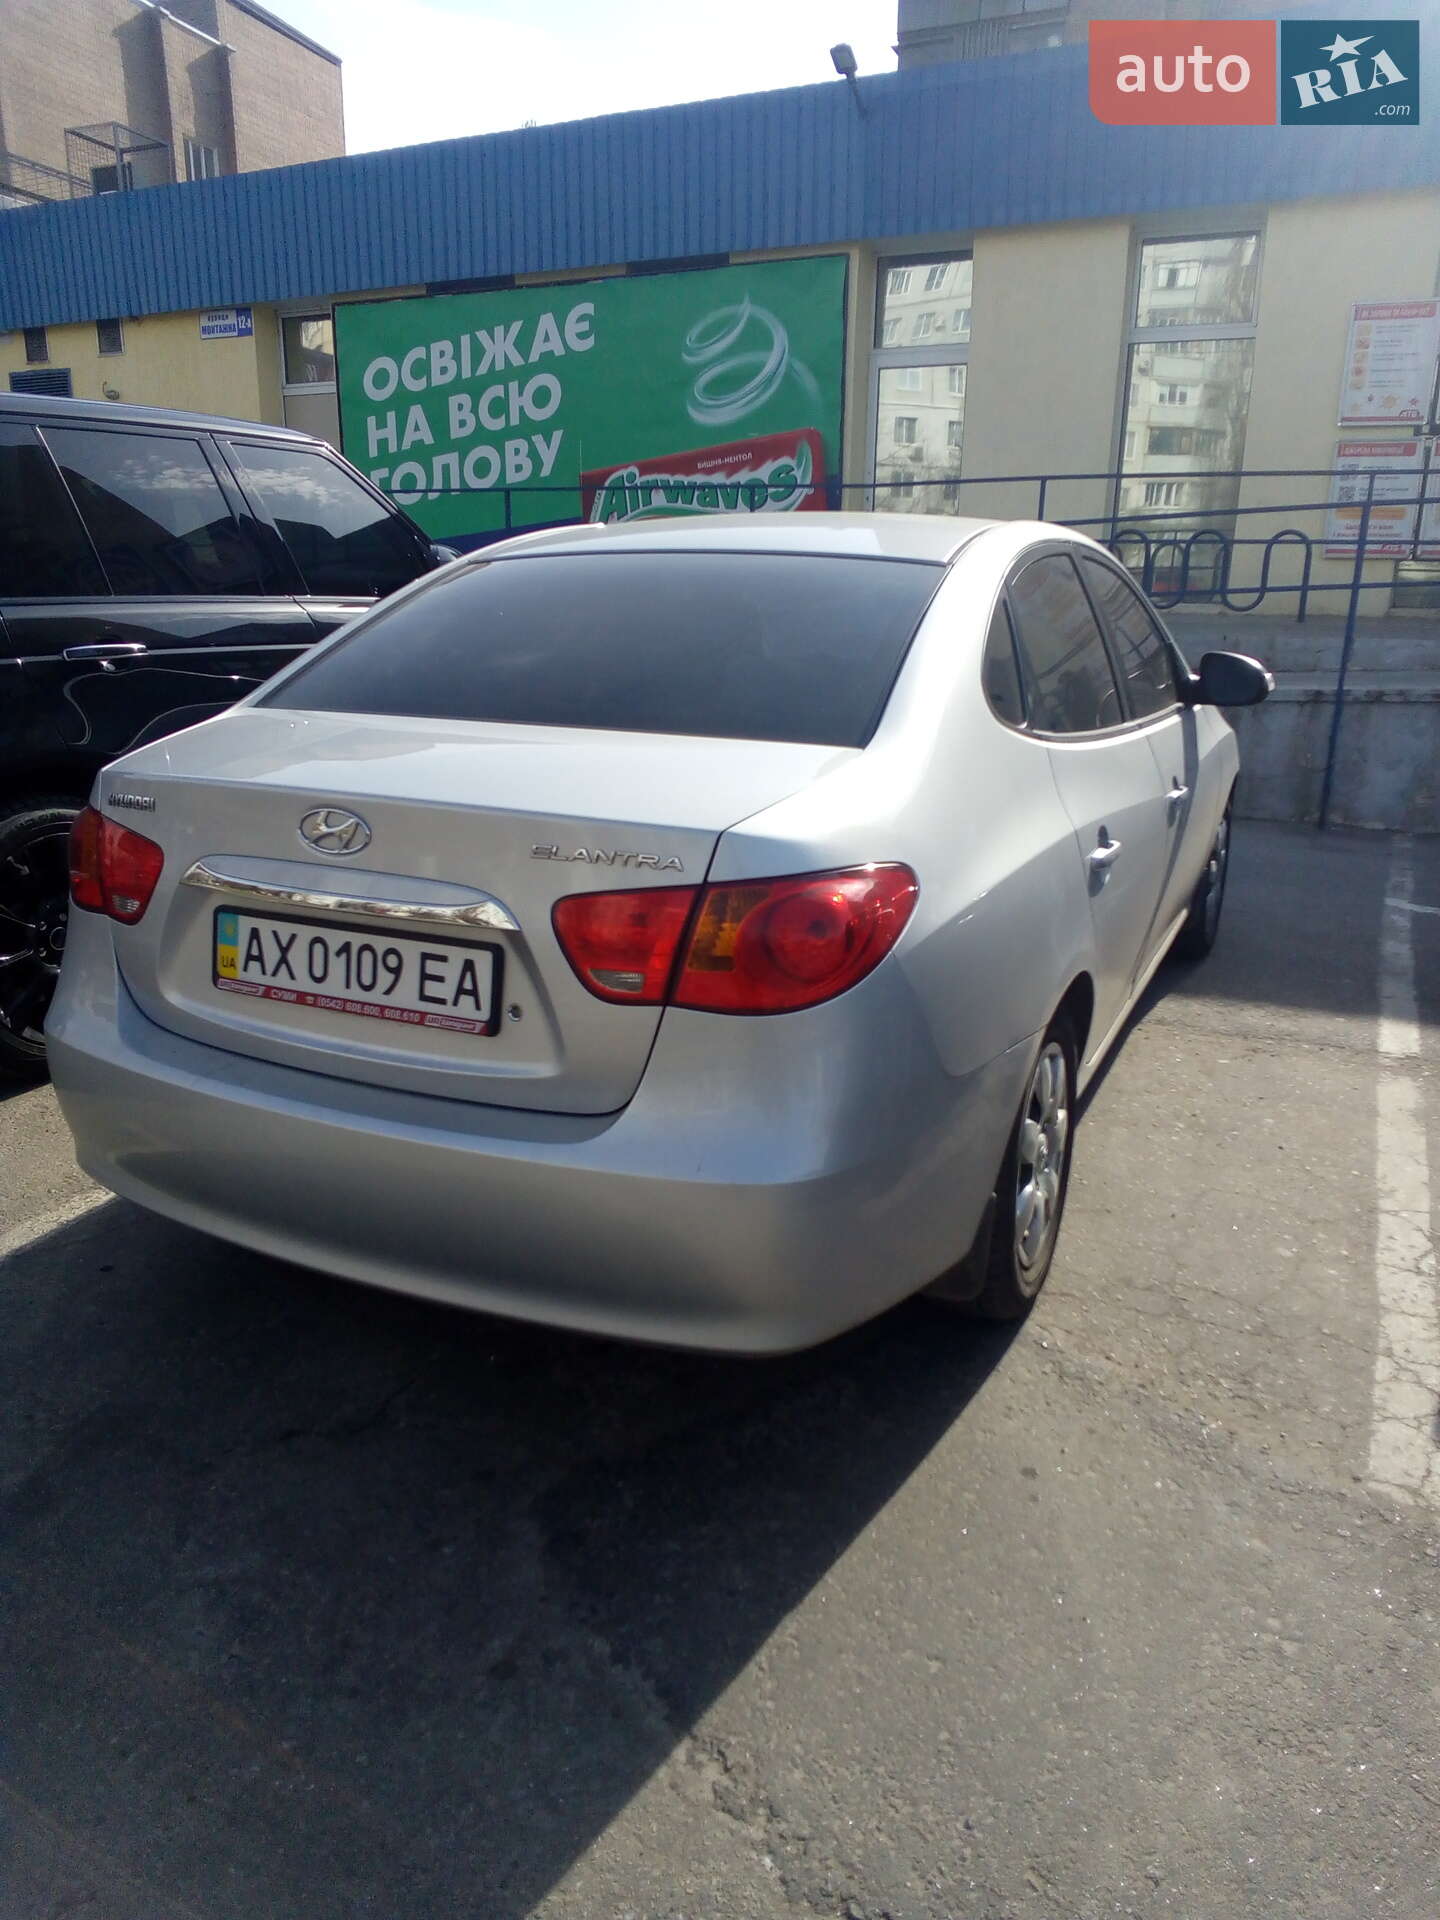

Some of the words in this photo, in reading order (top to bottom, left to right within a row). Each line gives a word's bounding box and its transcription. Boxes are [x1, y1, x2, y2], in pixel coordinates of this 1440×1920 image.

[363, 302, 595, 401] ОСВІЖАЄ
[366, 404, 435, 458] НА
[448, 373, 562, 440] ВСЮ
[598, 464, 798, 523] Airwaves
[530, 844, 685, 872] ELANTRA
[221, 955, 237, 969] UA
